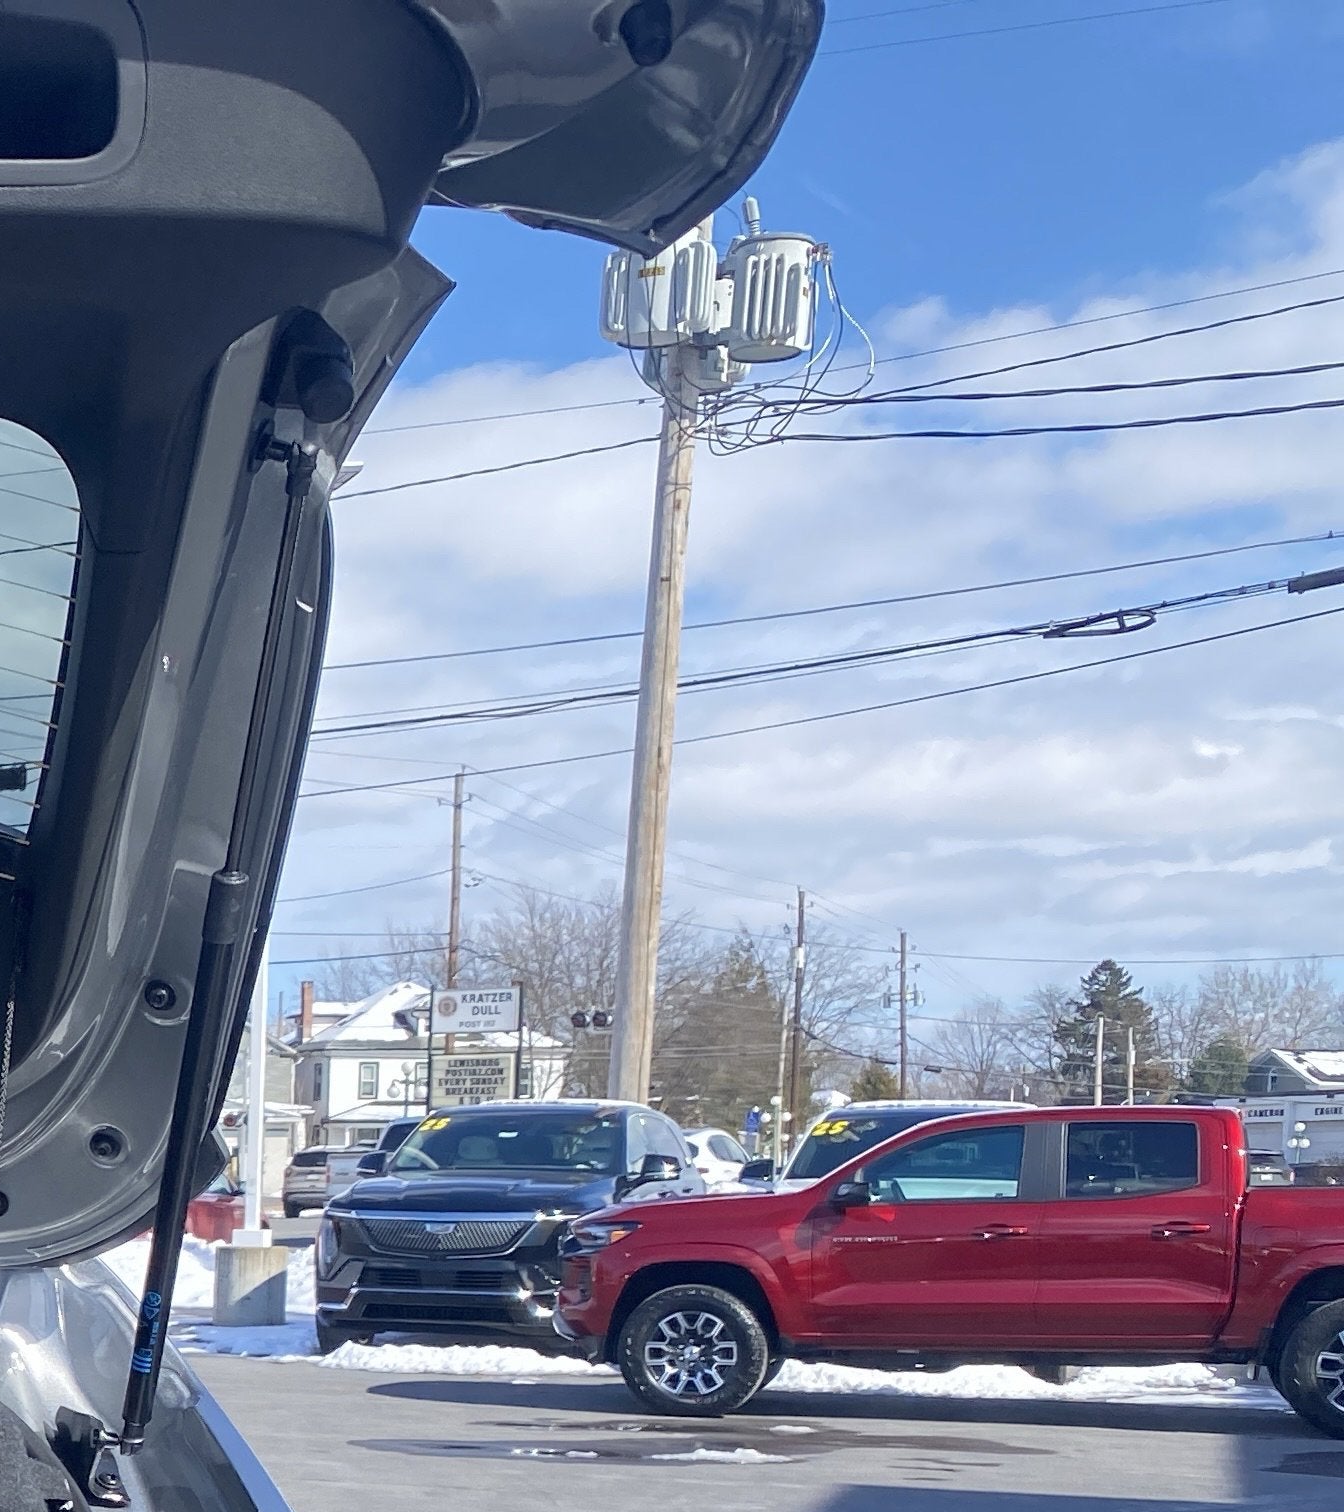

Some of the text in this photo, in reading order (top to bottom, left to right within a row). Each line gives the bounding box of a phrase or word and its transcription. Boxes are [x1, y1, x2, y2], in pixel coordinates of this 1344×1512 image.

[461, 992, 513, 1004] KRATZER
[472, 1006, 501, 1016] DULL
[448, 1058, 500, 1067] LEWISBURG
[438, 1077, 506, 1086] EVERY SUNDAY
[445, 1086, 498, 1095] BREAKFAST
[1248, 1107, 1344, 1117] CAMERON ENGINE
[812, 1120, 850, 1136] 25
